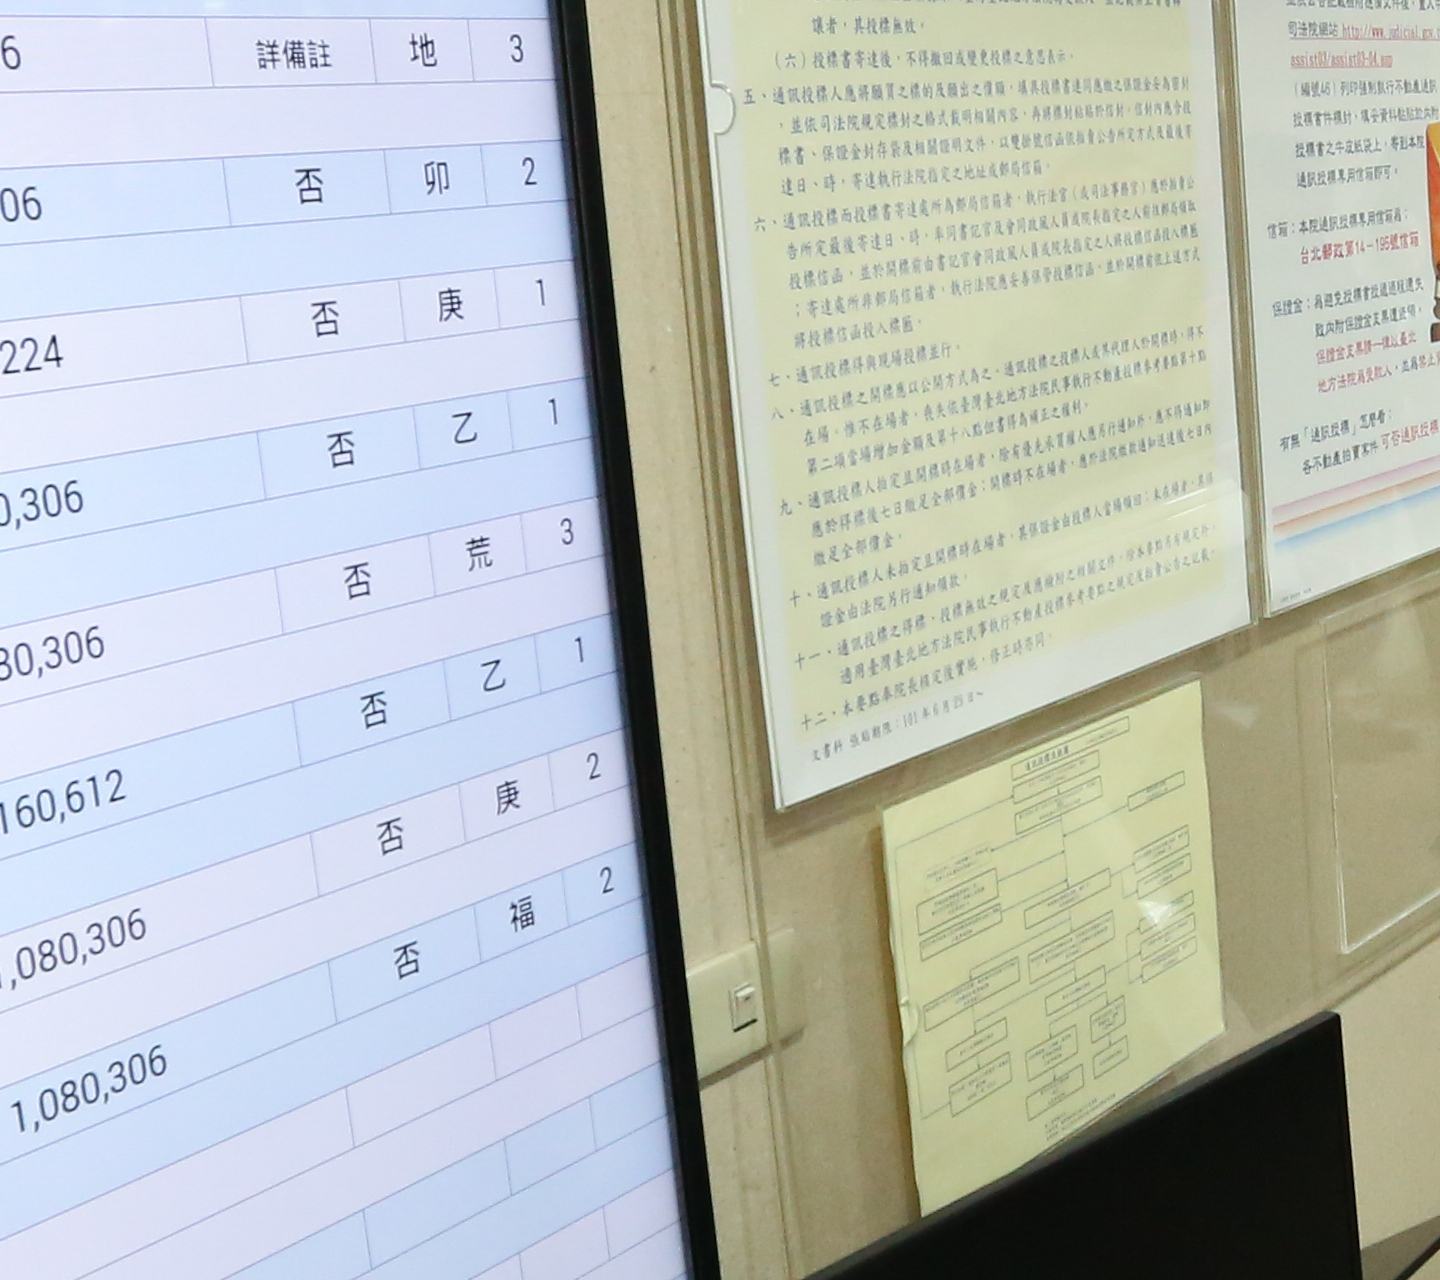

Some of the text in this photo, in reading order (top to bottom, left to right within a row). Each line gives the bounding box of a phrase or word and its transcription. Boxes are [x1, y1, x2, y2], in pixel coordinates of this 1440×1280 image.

[255, 39, 333, 71] 詳備註
[408, 33, 439, 68] 地
[509, 33, 524, 63] 3
[294, 167, 325, 205] 否
[423, 161, 450, 196] 卯
[521, 156, 537, 187] 2
[438, 287, 464, 323] 庚
[535, 279, 546, 308] 1
[310, 299, 341, 338] 否
[452, 412, 478, 445] 乙
[548, 398, 559, 426] 1
[326, 430, 357, 468] 否
[559, 518, 574, 547] 3
[464, 536, 494, 573] 荒
[343, 562, 373, 600] 否
[574, 637, 585, 664] 1
[481, 660, 507, 692] 乙
[359, 691, 389, 730] 否
[585, 752, 601, 781] 2
[495, 779, 522, 817] 庚
[376, 817, 405, 856] 否
[598, 867, 615, 895] 2
[509, 897, 536, 932] 福
[393, 942, 420, 980] 否
[10, 1043, 169, 1135] 1,080,306
